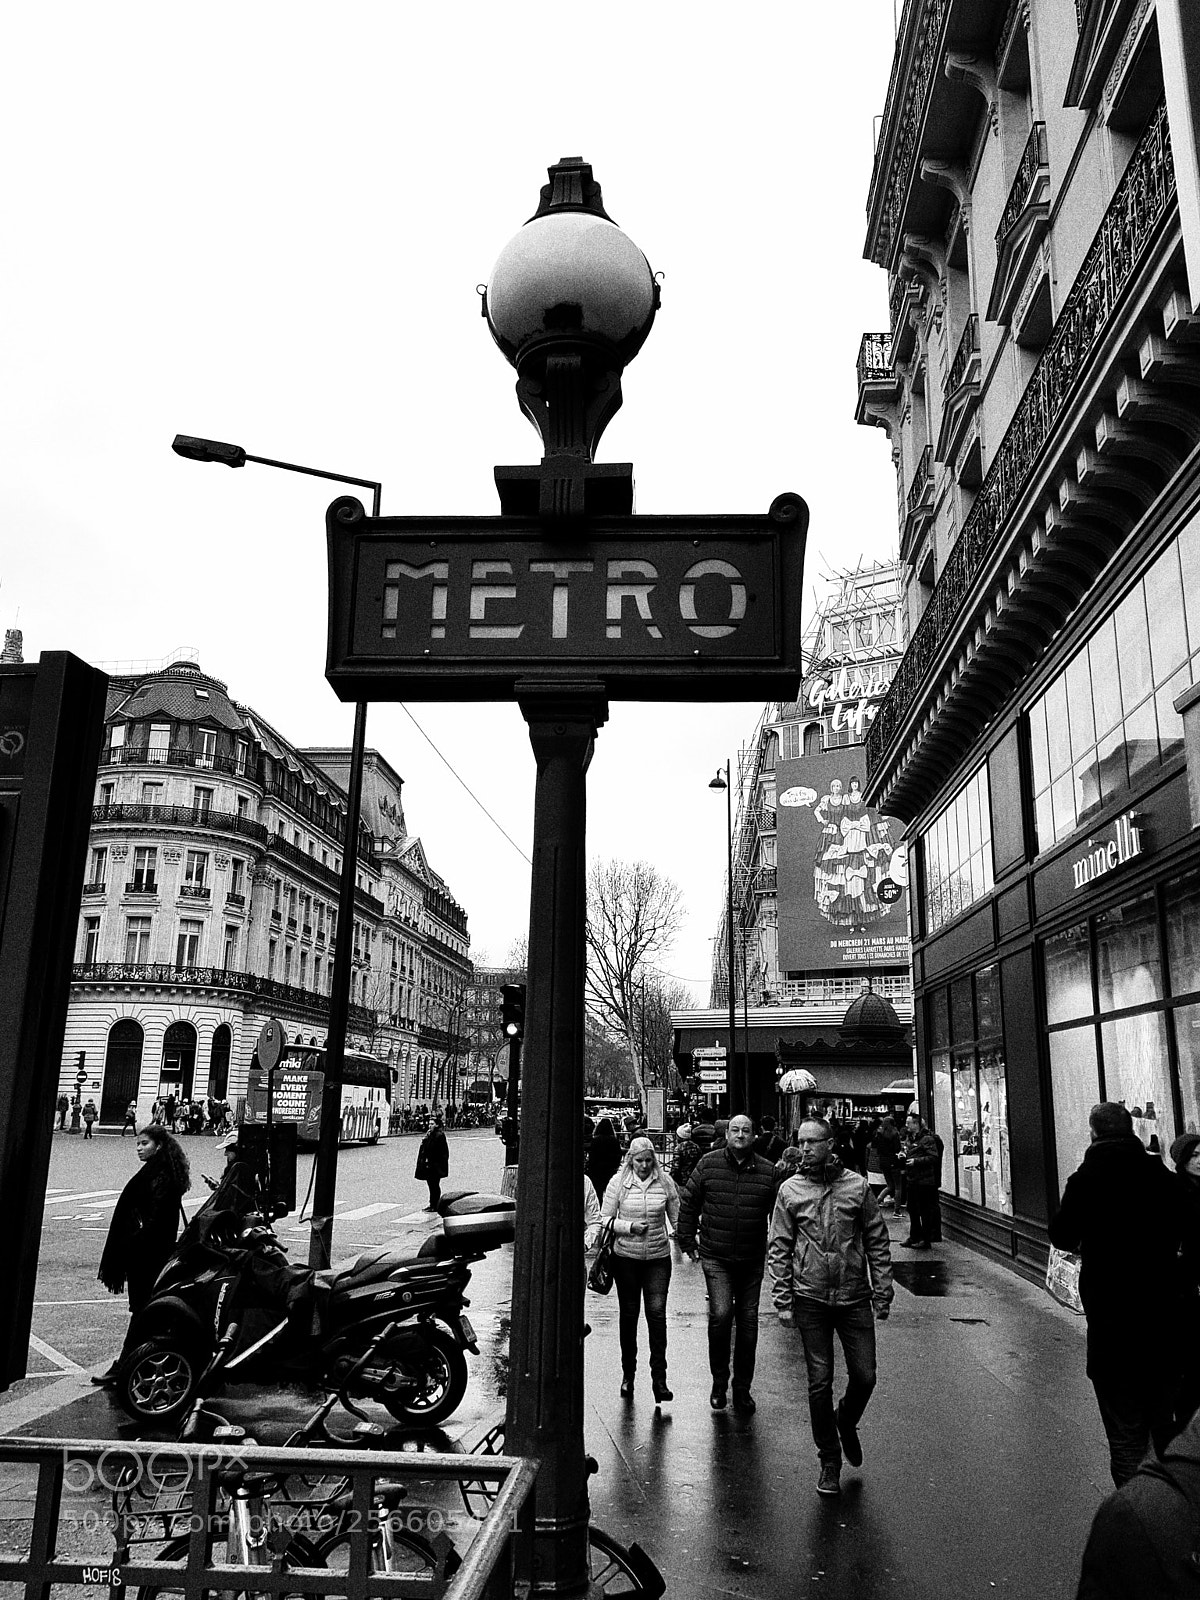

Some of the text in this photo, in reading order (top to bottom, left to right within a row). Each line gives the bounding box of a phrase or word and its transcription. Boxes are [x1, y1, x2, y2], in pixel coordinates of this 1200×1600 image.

[381, 557, 747, 640] METRO
[808, 667, 891, 714] Galeries
[1072, 810, 1142, 890] minelli
[838, 938, 863, 948] MERCREDI
[871, 937, 885, 946] MARS
[886, 936, 894, 945] AU
[895, 935, 909, 944] MARD
[279, 1057, 302, 1069] ntiki
[282, 1075, 308, 1083] MAKE
[280, 1084, 308, 1092] EVERY
[277, 1100, 308, 1108] COUNT.
